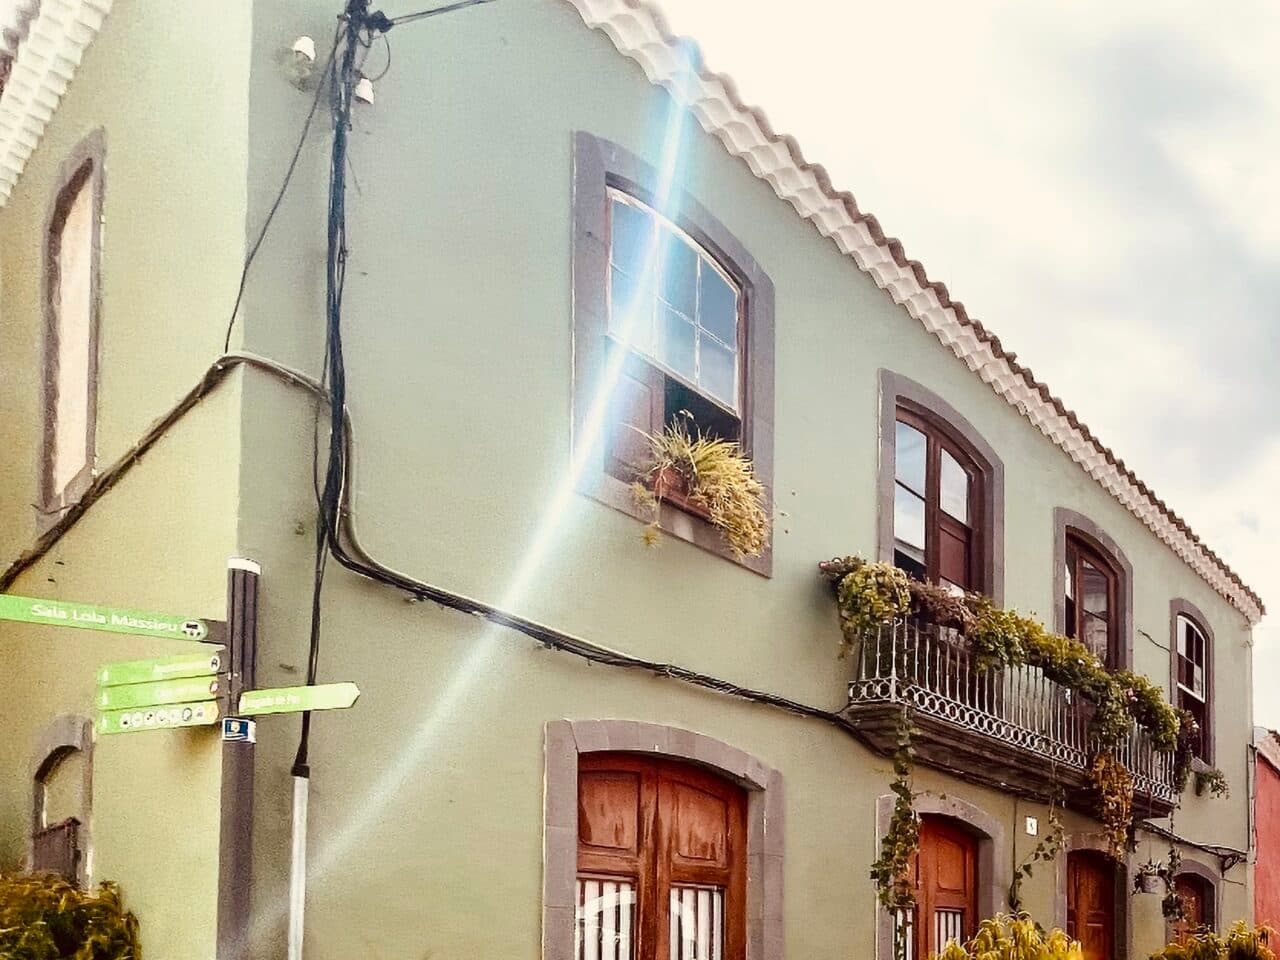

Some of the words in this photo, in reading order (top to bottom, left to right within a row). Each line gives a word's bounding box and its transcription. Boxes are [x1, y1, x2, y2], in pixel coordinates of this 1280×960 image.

[31, 604, 67, 619] Sala
[73, 609, 106, 624] Lola
[111, 614, 178, 632] Massieu
